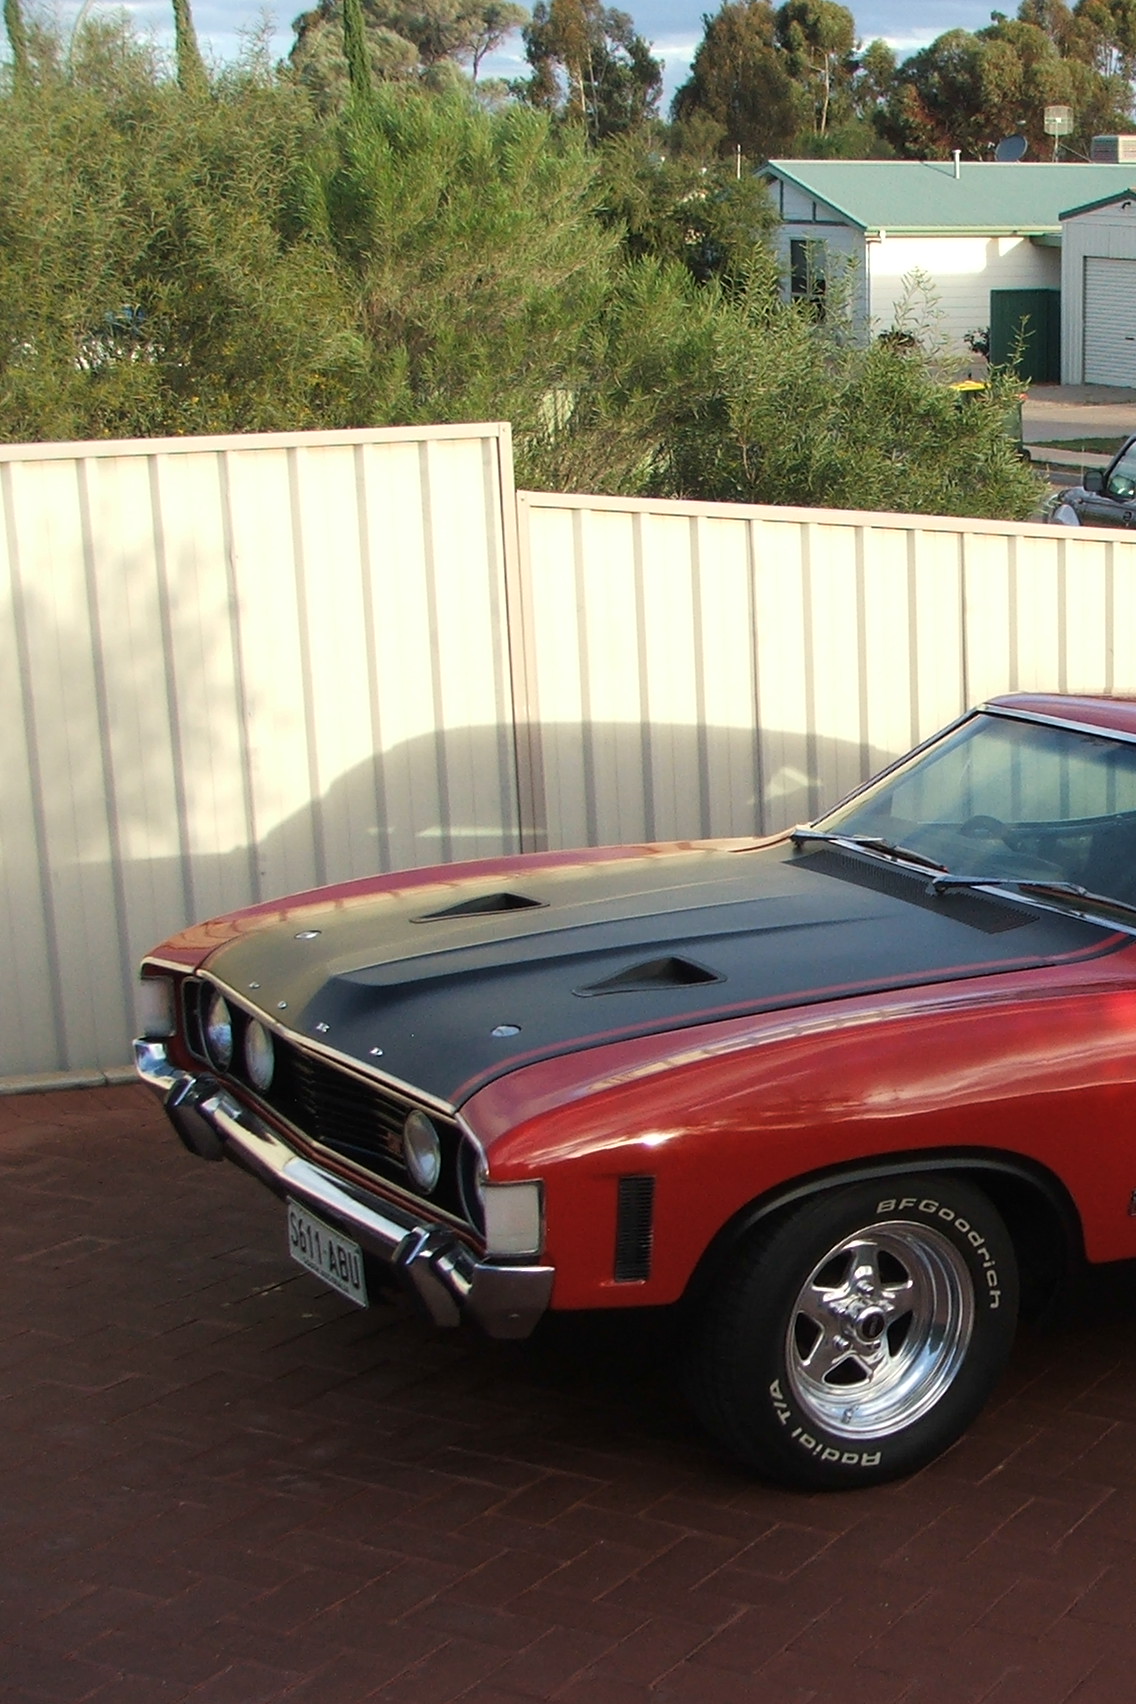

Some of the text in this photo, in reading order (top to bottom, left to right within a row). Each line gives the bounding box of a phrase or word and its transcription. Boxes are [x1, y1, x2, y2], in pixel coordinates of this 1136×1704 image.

[876, 1198, 1001, 1309] BFGoodrich
[769, 1378, 882, 1467] Radial T/A
